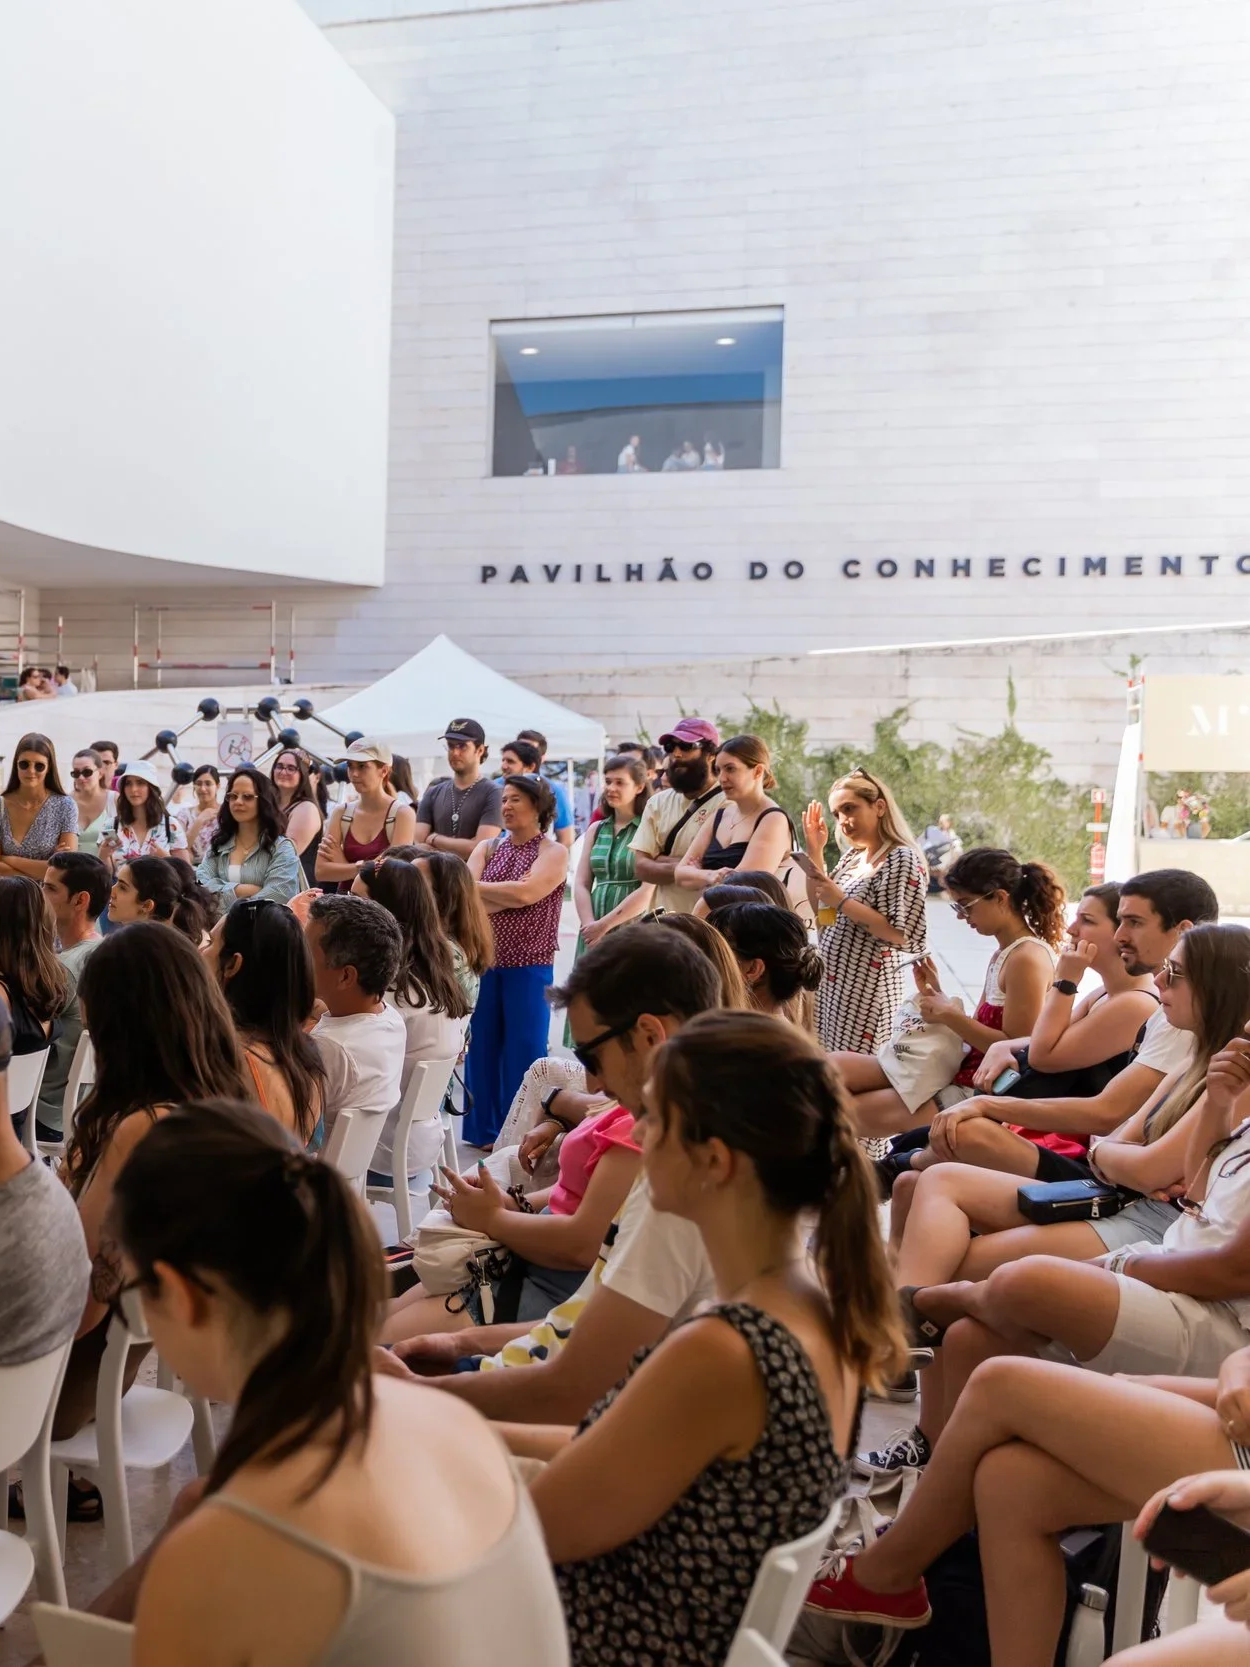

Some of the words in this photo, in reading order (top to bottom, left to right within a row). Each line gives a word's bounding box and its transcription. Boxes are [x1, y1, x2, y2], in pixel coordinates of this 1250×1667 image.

[480, 557, 714, 584] PAVILHÃO
[749, 560, 805, 581] DO
[842, 554, 1250, 579] CONHECIMENTO
